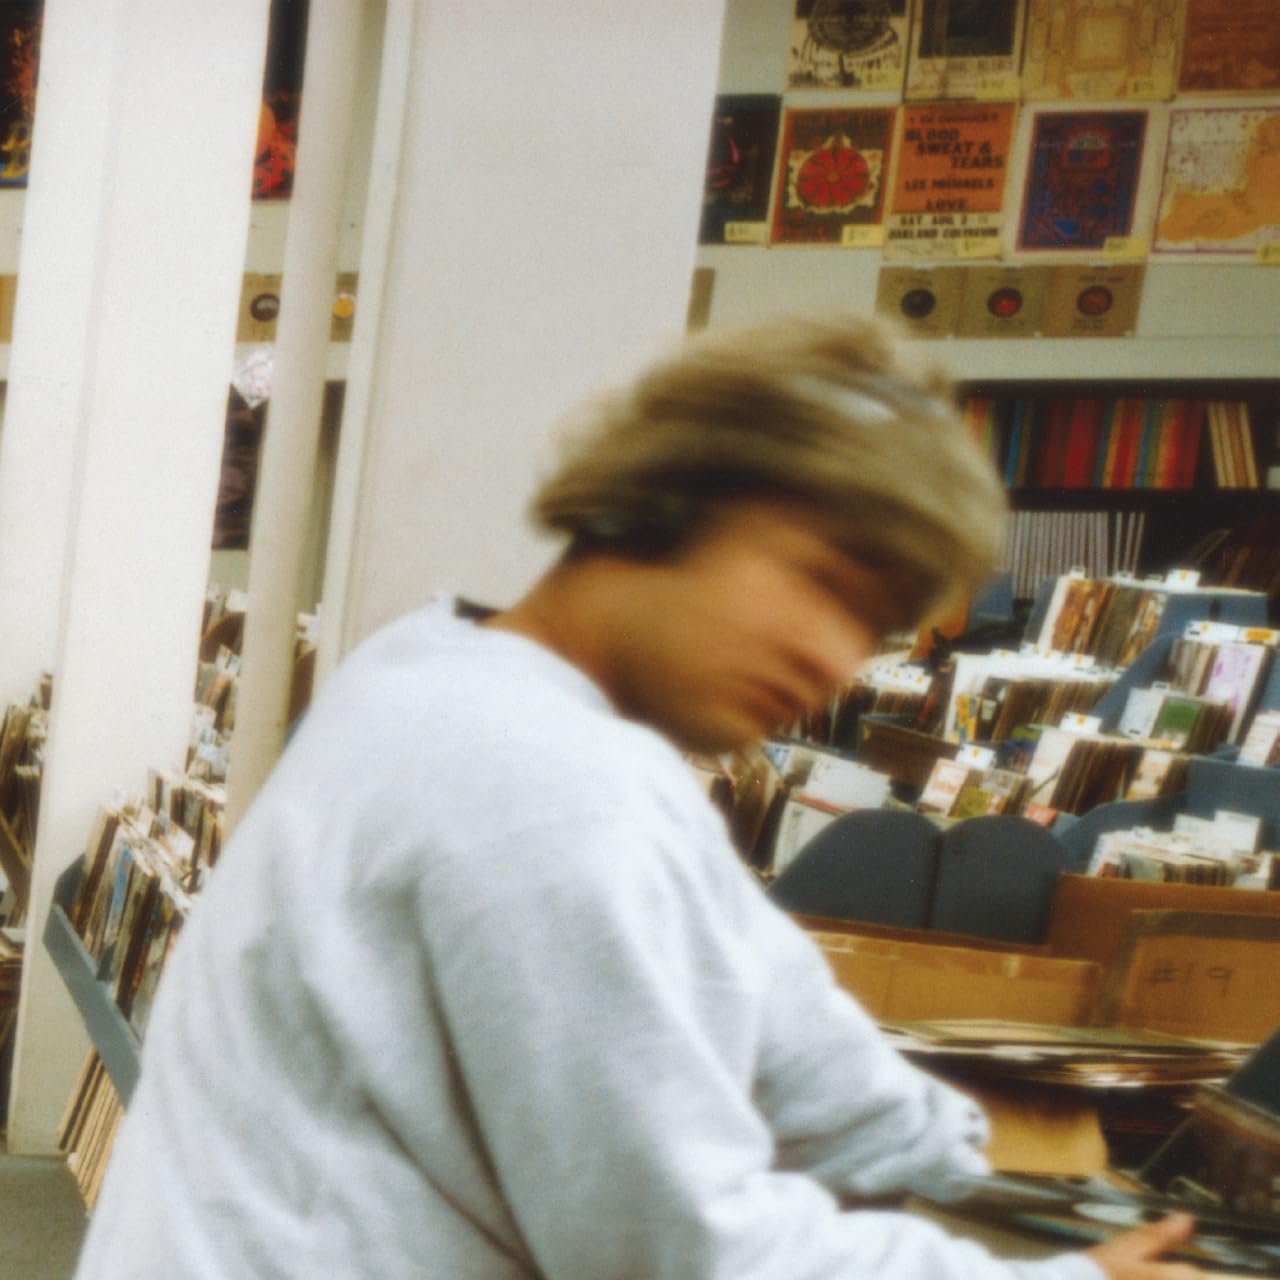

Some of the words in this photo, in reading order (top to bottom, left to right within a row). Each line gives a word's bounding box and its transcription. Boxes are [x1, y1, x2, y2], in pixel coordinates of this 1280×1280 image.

[905, 128, 960, 141] BLOOD
[916, 141, 975, 155] SWEAT
[951, 155, 1004, 169] TEARS
[925, 199, 966, 211] LOVE
